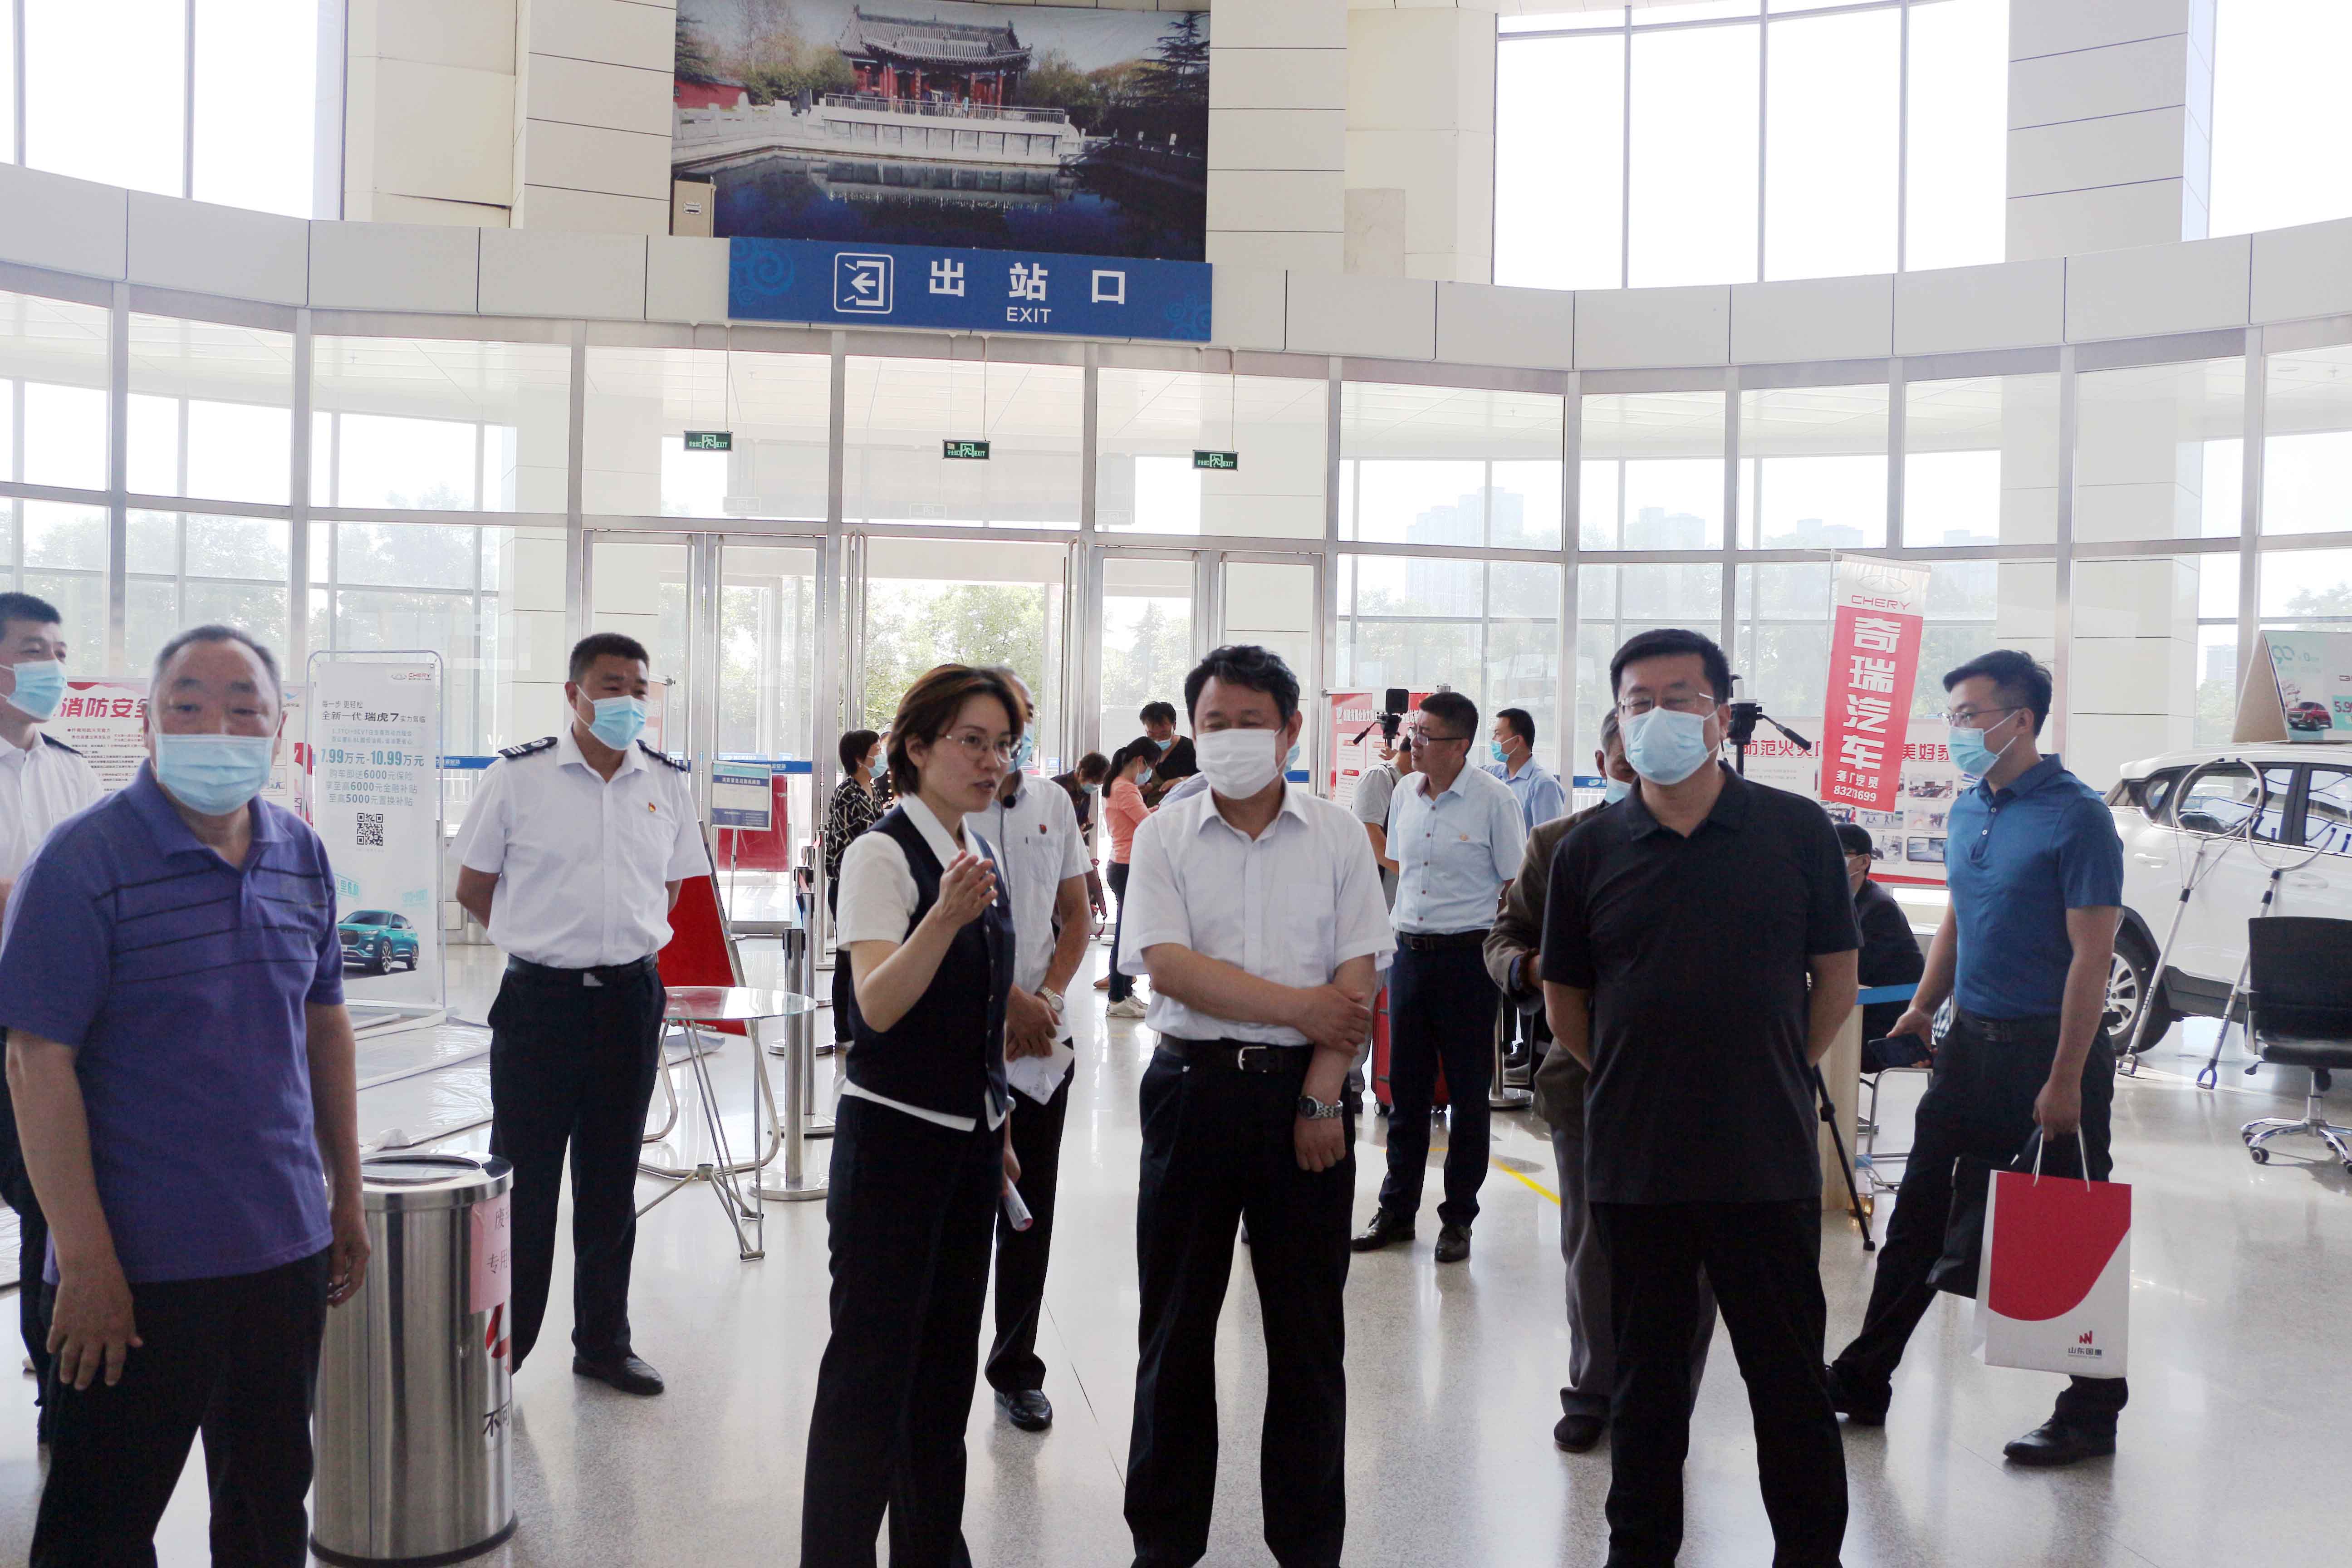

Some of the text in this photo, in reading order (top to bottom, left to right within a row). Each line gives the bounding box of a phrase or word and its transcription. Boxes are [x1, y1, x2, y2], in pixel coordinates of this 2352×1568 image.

[929, 258, 1126, 304] 出站口
[1006, 306, 1052, 323] EXIT
[1851, 595, 1911, 610] CHERY
[1840, 617, 1902, 770] 奇瑞汽车
[343, 700, 363, 708] 更轻松
[2334, 701, 2352, 713] 5.9
[322, 711, 362, 721] 全新一代
[364, 712, 399, 722] 瑞虎7
[321, 749, 425, 767] 7.99万元-10.99万元
[329, 769, 414, 781] 购车即送6000元保险
